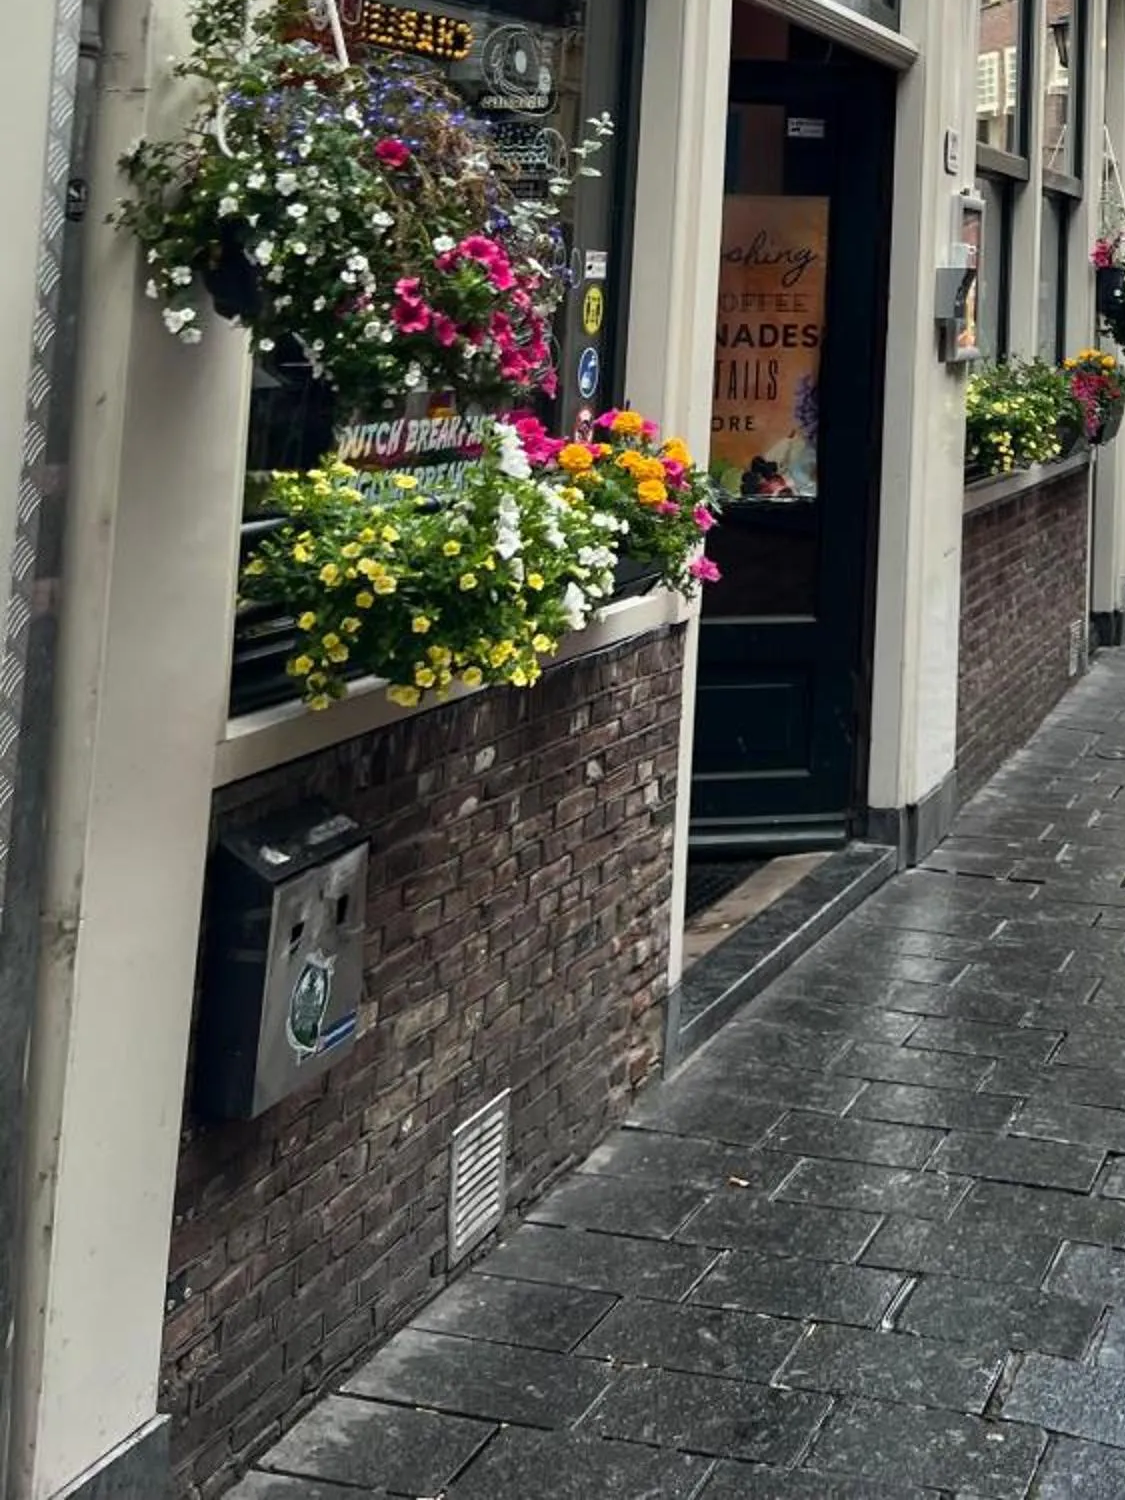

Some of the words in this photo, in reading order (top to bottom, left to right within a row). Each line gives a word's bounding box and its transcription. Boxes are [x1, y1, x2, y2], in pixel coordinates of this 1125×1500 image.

[724, 230, 817, 288] shing
[721, 292, 810, 314] OFFEE
[716, 323, 819, 349] NADES
[715, 359, 779, 401] TAILS
[338, 418, 404, 459] DUTCH
[711, 415, 756, 433] ORE
